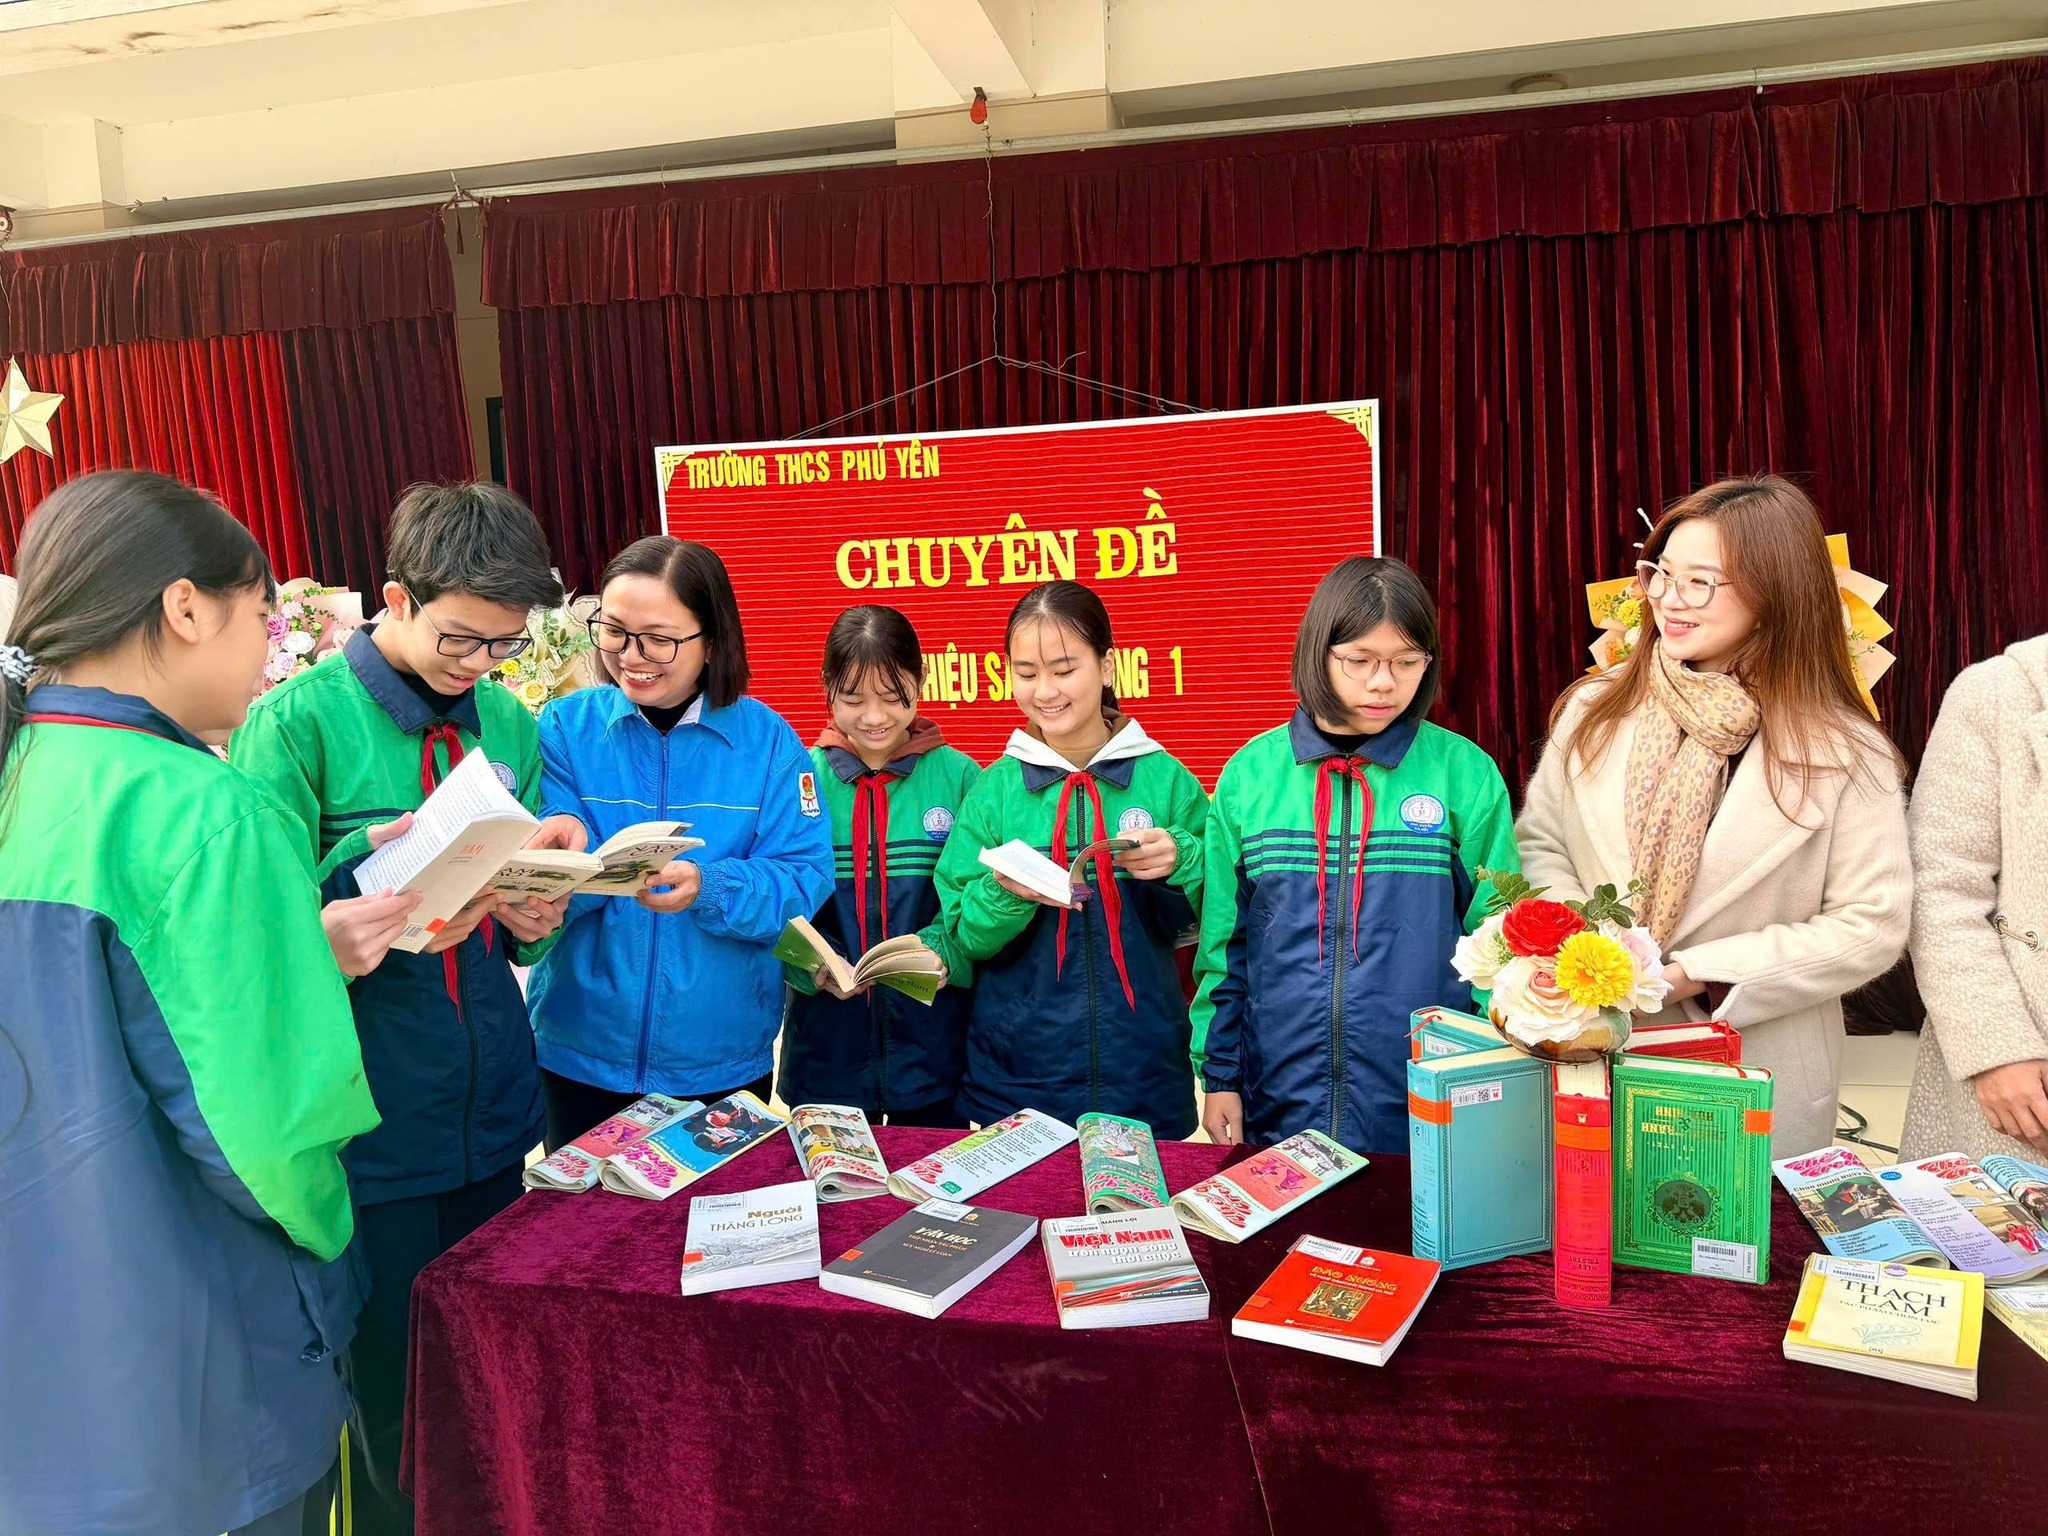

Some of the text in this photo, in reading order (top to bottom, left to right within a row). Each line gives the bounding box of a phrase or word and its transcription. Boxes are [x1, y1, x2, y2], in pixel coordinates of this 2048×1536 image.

[685, 437, 940, 489] TRƯỜNG THCS PHÚ YÊN
[835, 486, 1178, 590] CHUYÊN ĐỀ
[1169, 645, 1184, 696] 1
[710, 1213, 802, 1232] THĂNG LONG
[747, 1204, 802, 1219] Người
[915, 1226, 978, 1245] VĂN HỌC
[1059, 1228, 1174, 1249] Việt Nam
[1840, 1278, 1947, 1308] THẠCH
[1860, 1294, 1932, 1318] LAM
